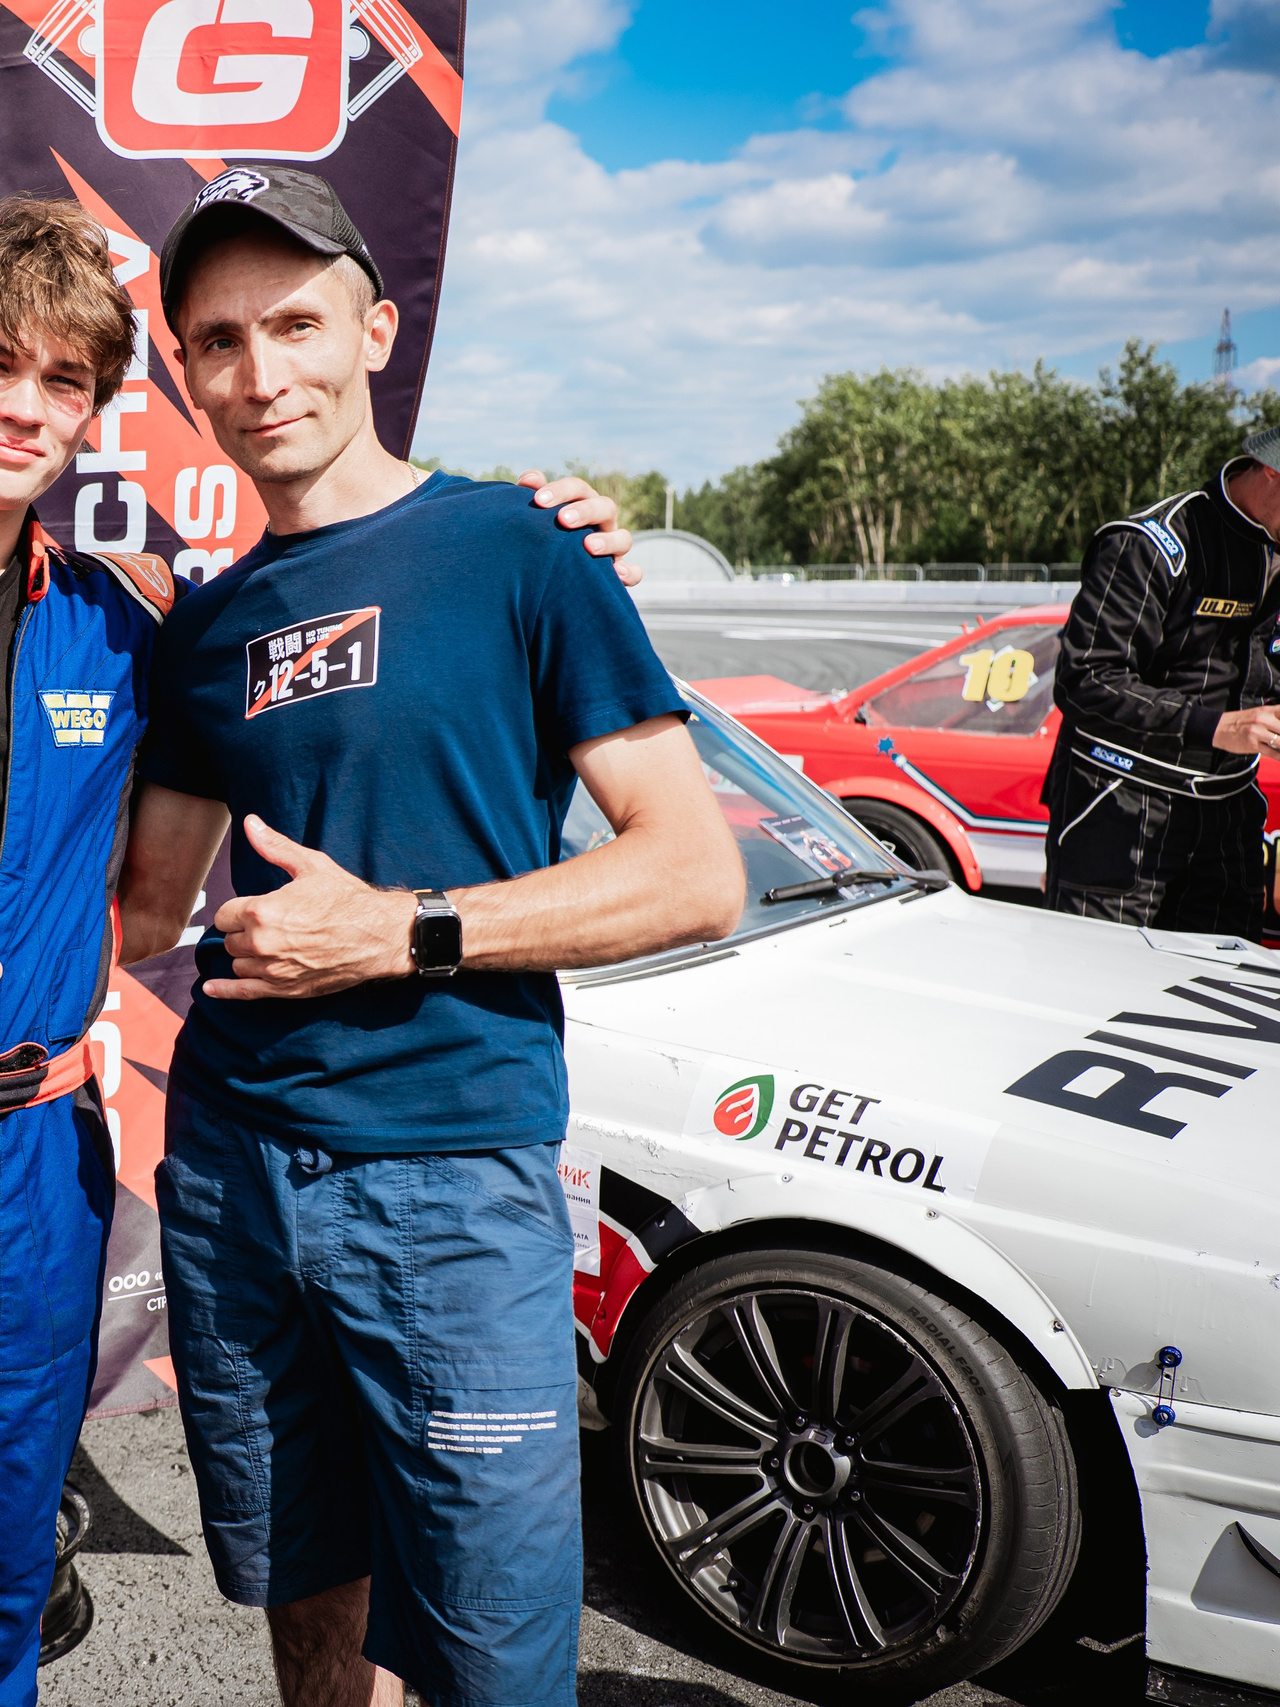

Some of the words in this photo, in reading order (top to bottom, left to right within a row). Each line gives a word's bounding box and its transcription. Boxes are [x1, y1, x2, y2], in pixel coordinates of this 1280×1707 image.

[131, 0, 314, 126] G
[1200, 600, 1235, 615] ULD
[49, 709, 107, 729] WEGO
[789, 1083, 882, 1125] GET
[774, 1117, 946, 1193] PETROL
[108, 1270, 150, 1292] ООО
[906, 1306, 957, 1355] RADIAL
[955, 1356, 987, 1397] F205
